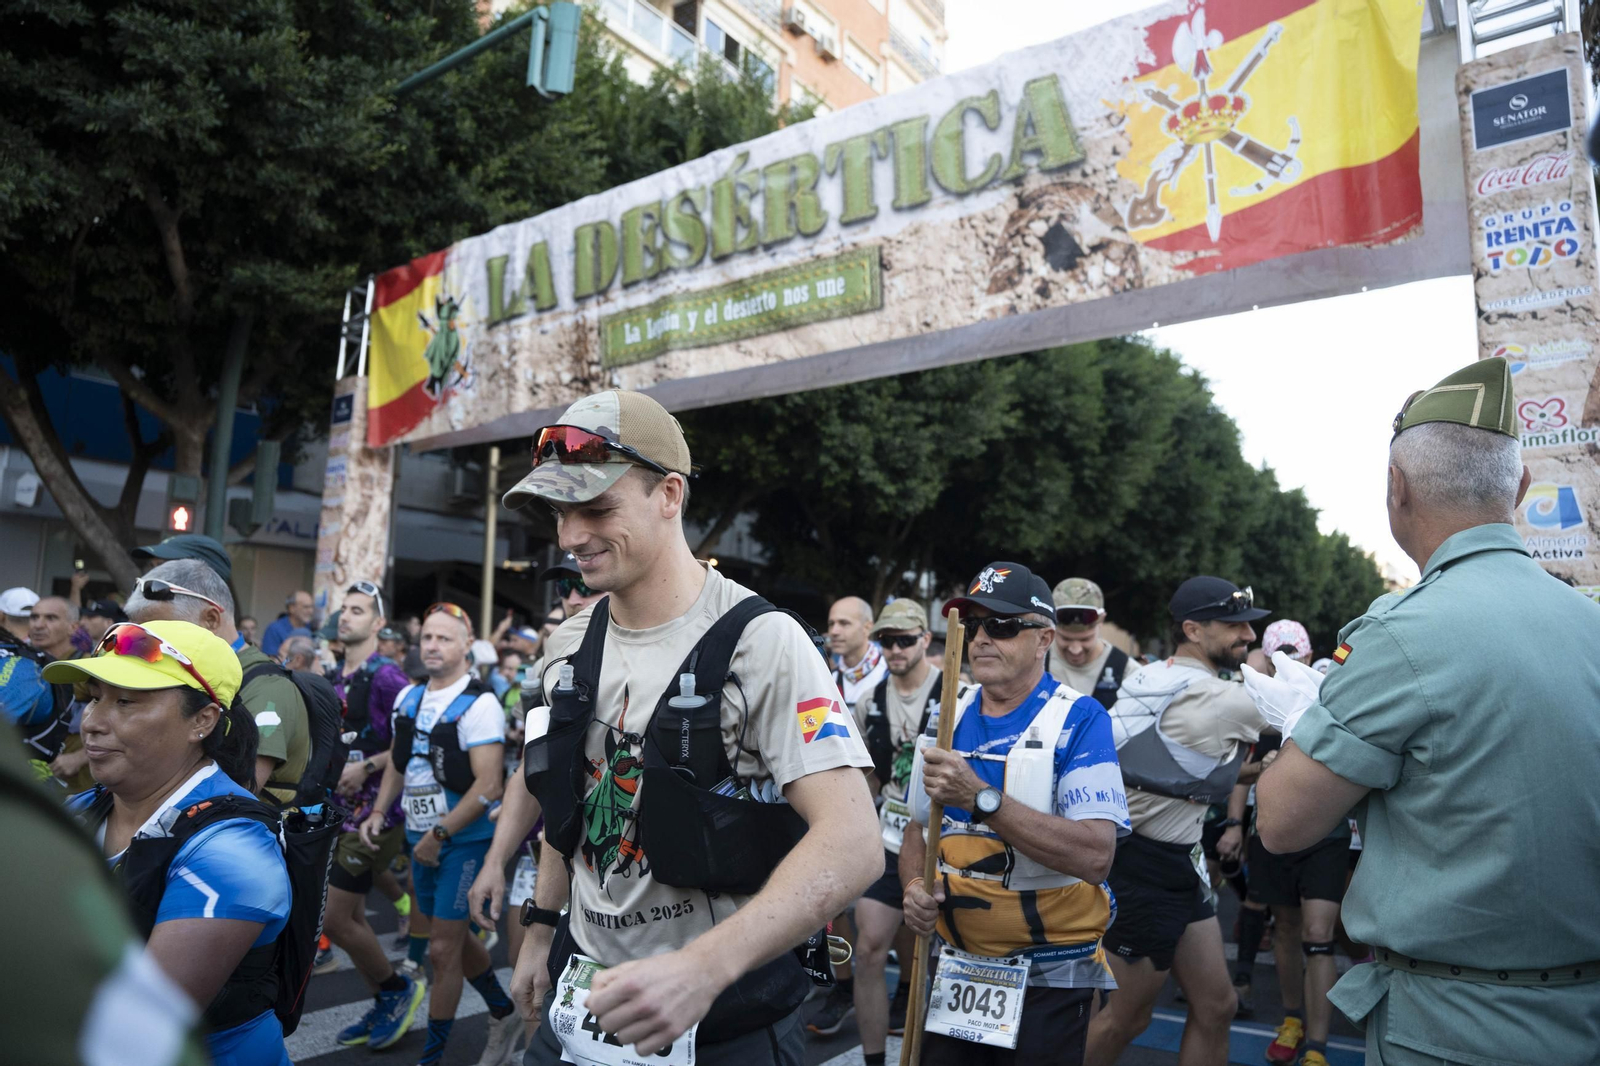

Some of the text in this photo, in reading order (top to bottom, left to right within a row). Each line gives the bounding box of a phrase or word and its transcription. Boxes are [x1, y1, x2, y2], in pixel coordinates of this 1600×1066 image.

[1493, 106, 1547, 126] SENATOR
[486, 73, 1085, 327] LA DESÉRTICA
[1485, 202, 1571, 227] GRUPO
[1486, 216, 1576, 248] RENTA
[1487, 239, 1578, 269] TODO
[624, 322, 642, 345] La
[687, 310, 698, 332] y
[704, 302, 718, 325] el
[723, 290, 777, 321] desierto
[783, 285, 809, 306] nos
[816, 276, 846, 299] une
[1527, 534, 1587, 548] Almería
[1532, 548, 1583, 560] Activa
[314, 836, 338, 942] SALOMON
[581, 898, 694, 929] SERTICA 2025
[1057, 948, 1081, 956] MONDIAL
[947, 982, 1007, 1020] 3043
[967, 1019, 999, 1030] PACO MOTA
